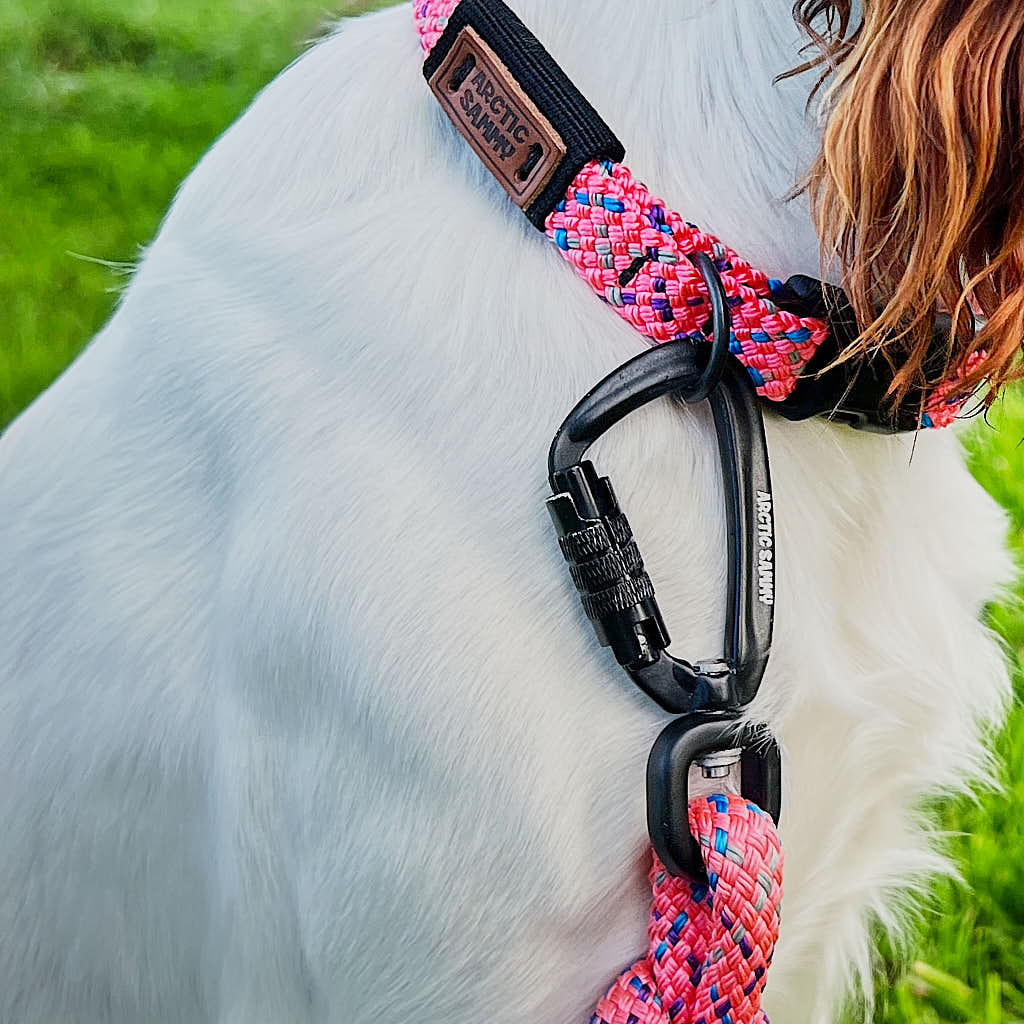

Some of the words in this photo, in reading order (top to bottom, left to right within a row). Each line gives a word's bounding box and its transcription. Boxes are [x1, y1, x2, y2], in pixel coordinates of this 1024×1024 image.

[460, 89, 515, 160] SAMMY
[472, 71, 530, 144] ARCTIC
[757, 490, 772, 548] ARCTIC
[757, 549, 773, 604] SAMMY
